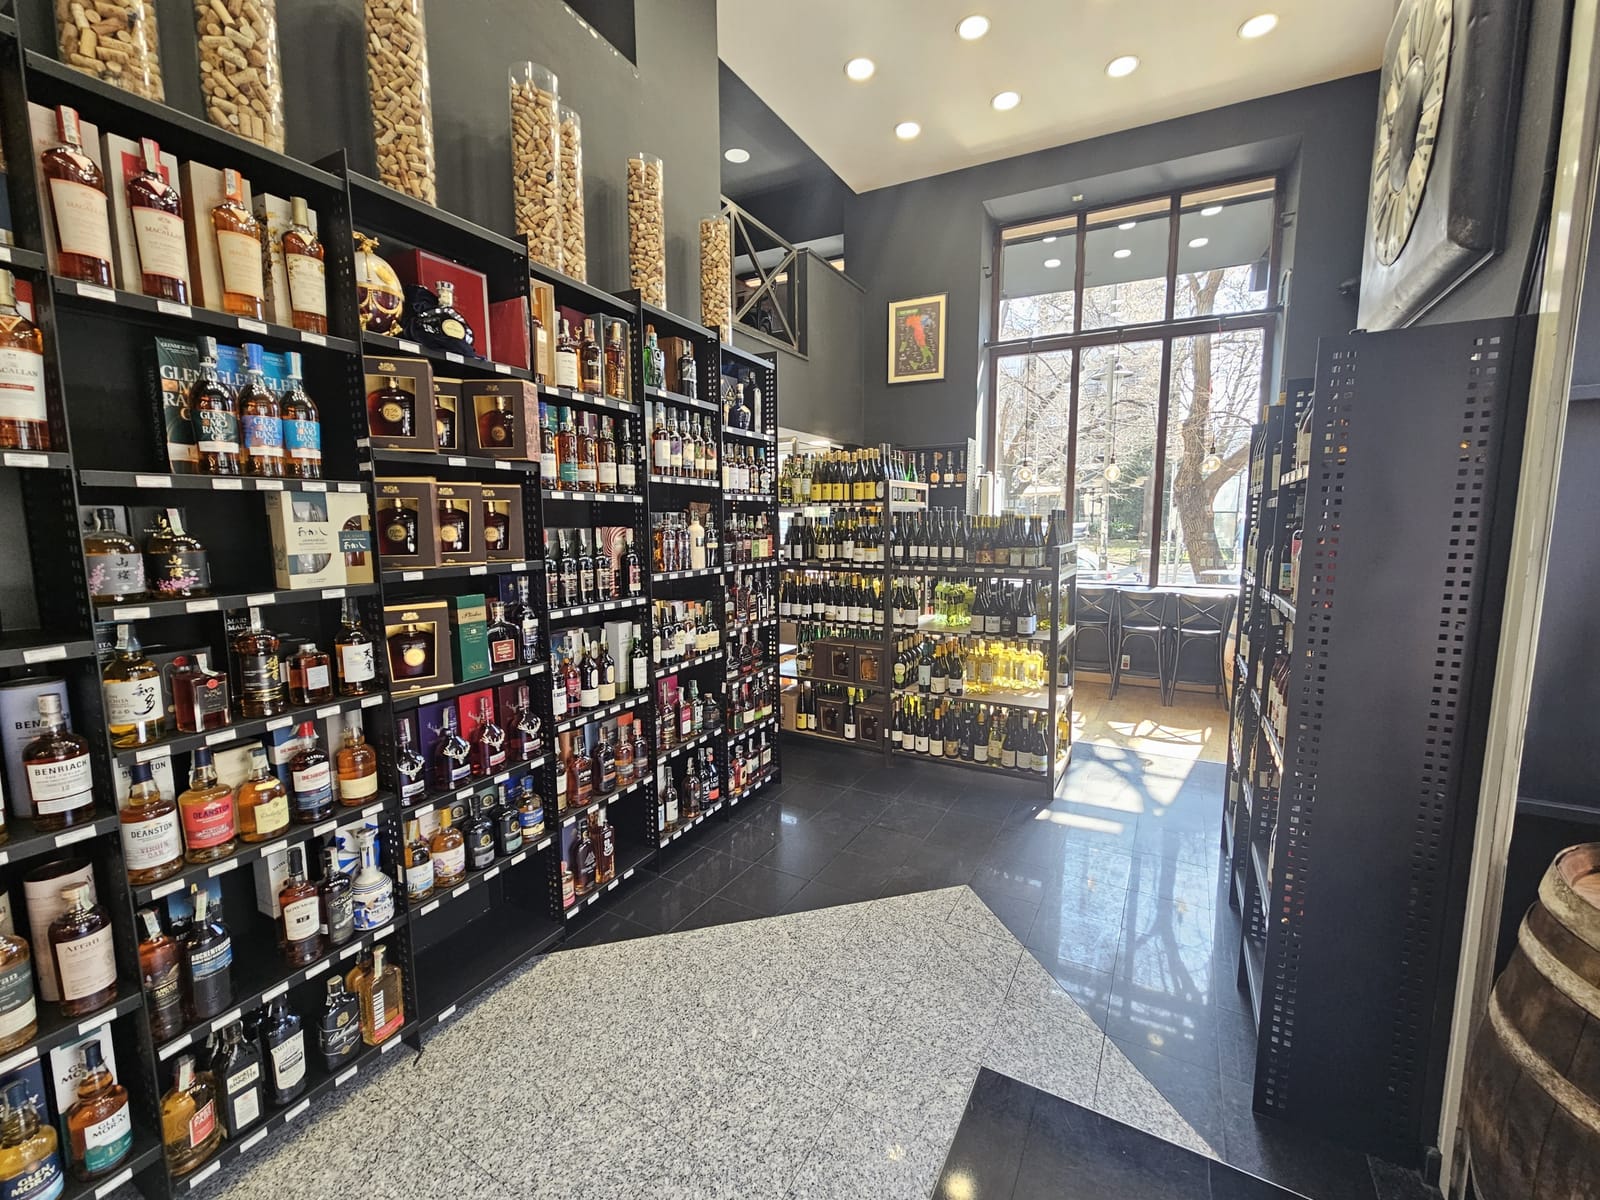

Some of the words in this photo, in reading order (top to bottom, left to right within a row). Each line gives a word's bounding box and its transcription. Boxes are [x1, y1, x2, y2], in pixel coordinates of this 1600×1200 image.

[145, 226, 183, 239] MACALLAN
[200, 411, 226, 421] GLEN
[253, 417, 277, 427] GLEN
[295, 421, 316, 429] GLEN
[34, 760, 88, 776] BENRIACH
[193, 804, 230, 820] DEANSTON
[131, 823, 174, 839] DEANSTON
[65, 937, 101, 953] Arran
[92, 1115, 127, 1138] MORAY
[97, 1113, 122, 1131] GLEN
[11, 1165, 56, 1197] MORAY
[17, 1163, 52, 1187] GLEN
